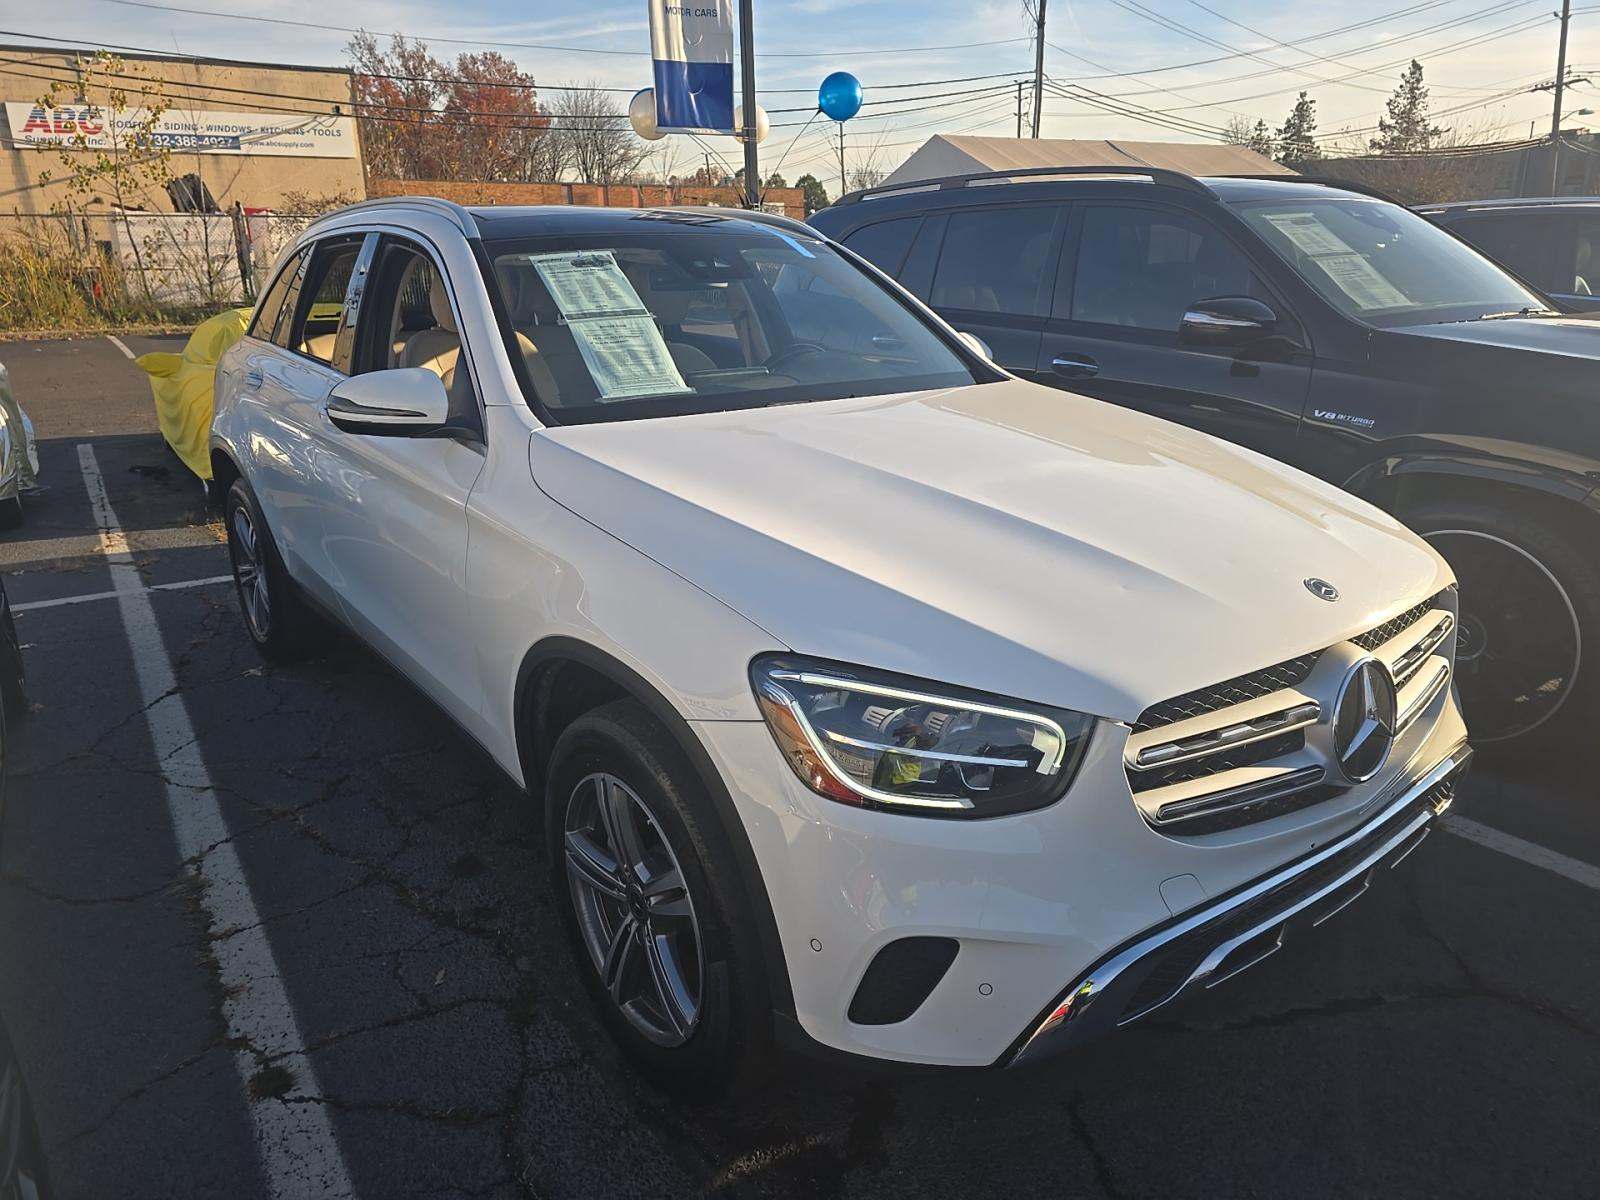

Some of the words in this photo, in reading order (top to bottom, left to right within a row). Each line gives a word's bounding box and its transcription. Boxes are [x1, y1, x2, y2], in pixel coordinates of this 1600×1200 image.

[665, 5, 691, 16] MOTOR
[694, 8, 718, 17] CARS
[18, 105, 106, 135] ABC
[164, 122, 199, 131] SIDING
[206, 124, 252, 134] WINDOWS
[313, 128, 342, 137] TOOLS
[1314, 410, 1337, 419] V8
[1337, 414, 1375, 425] BITURBO
